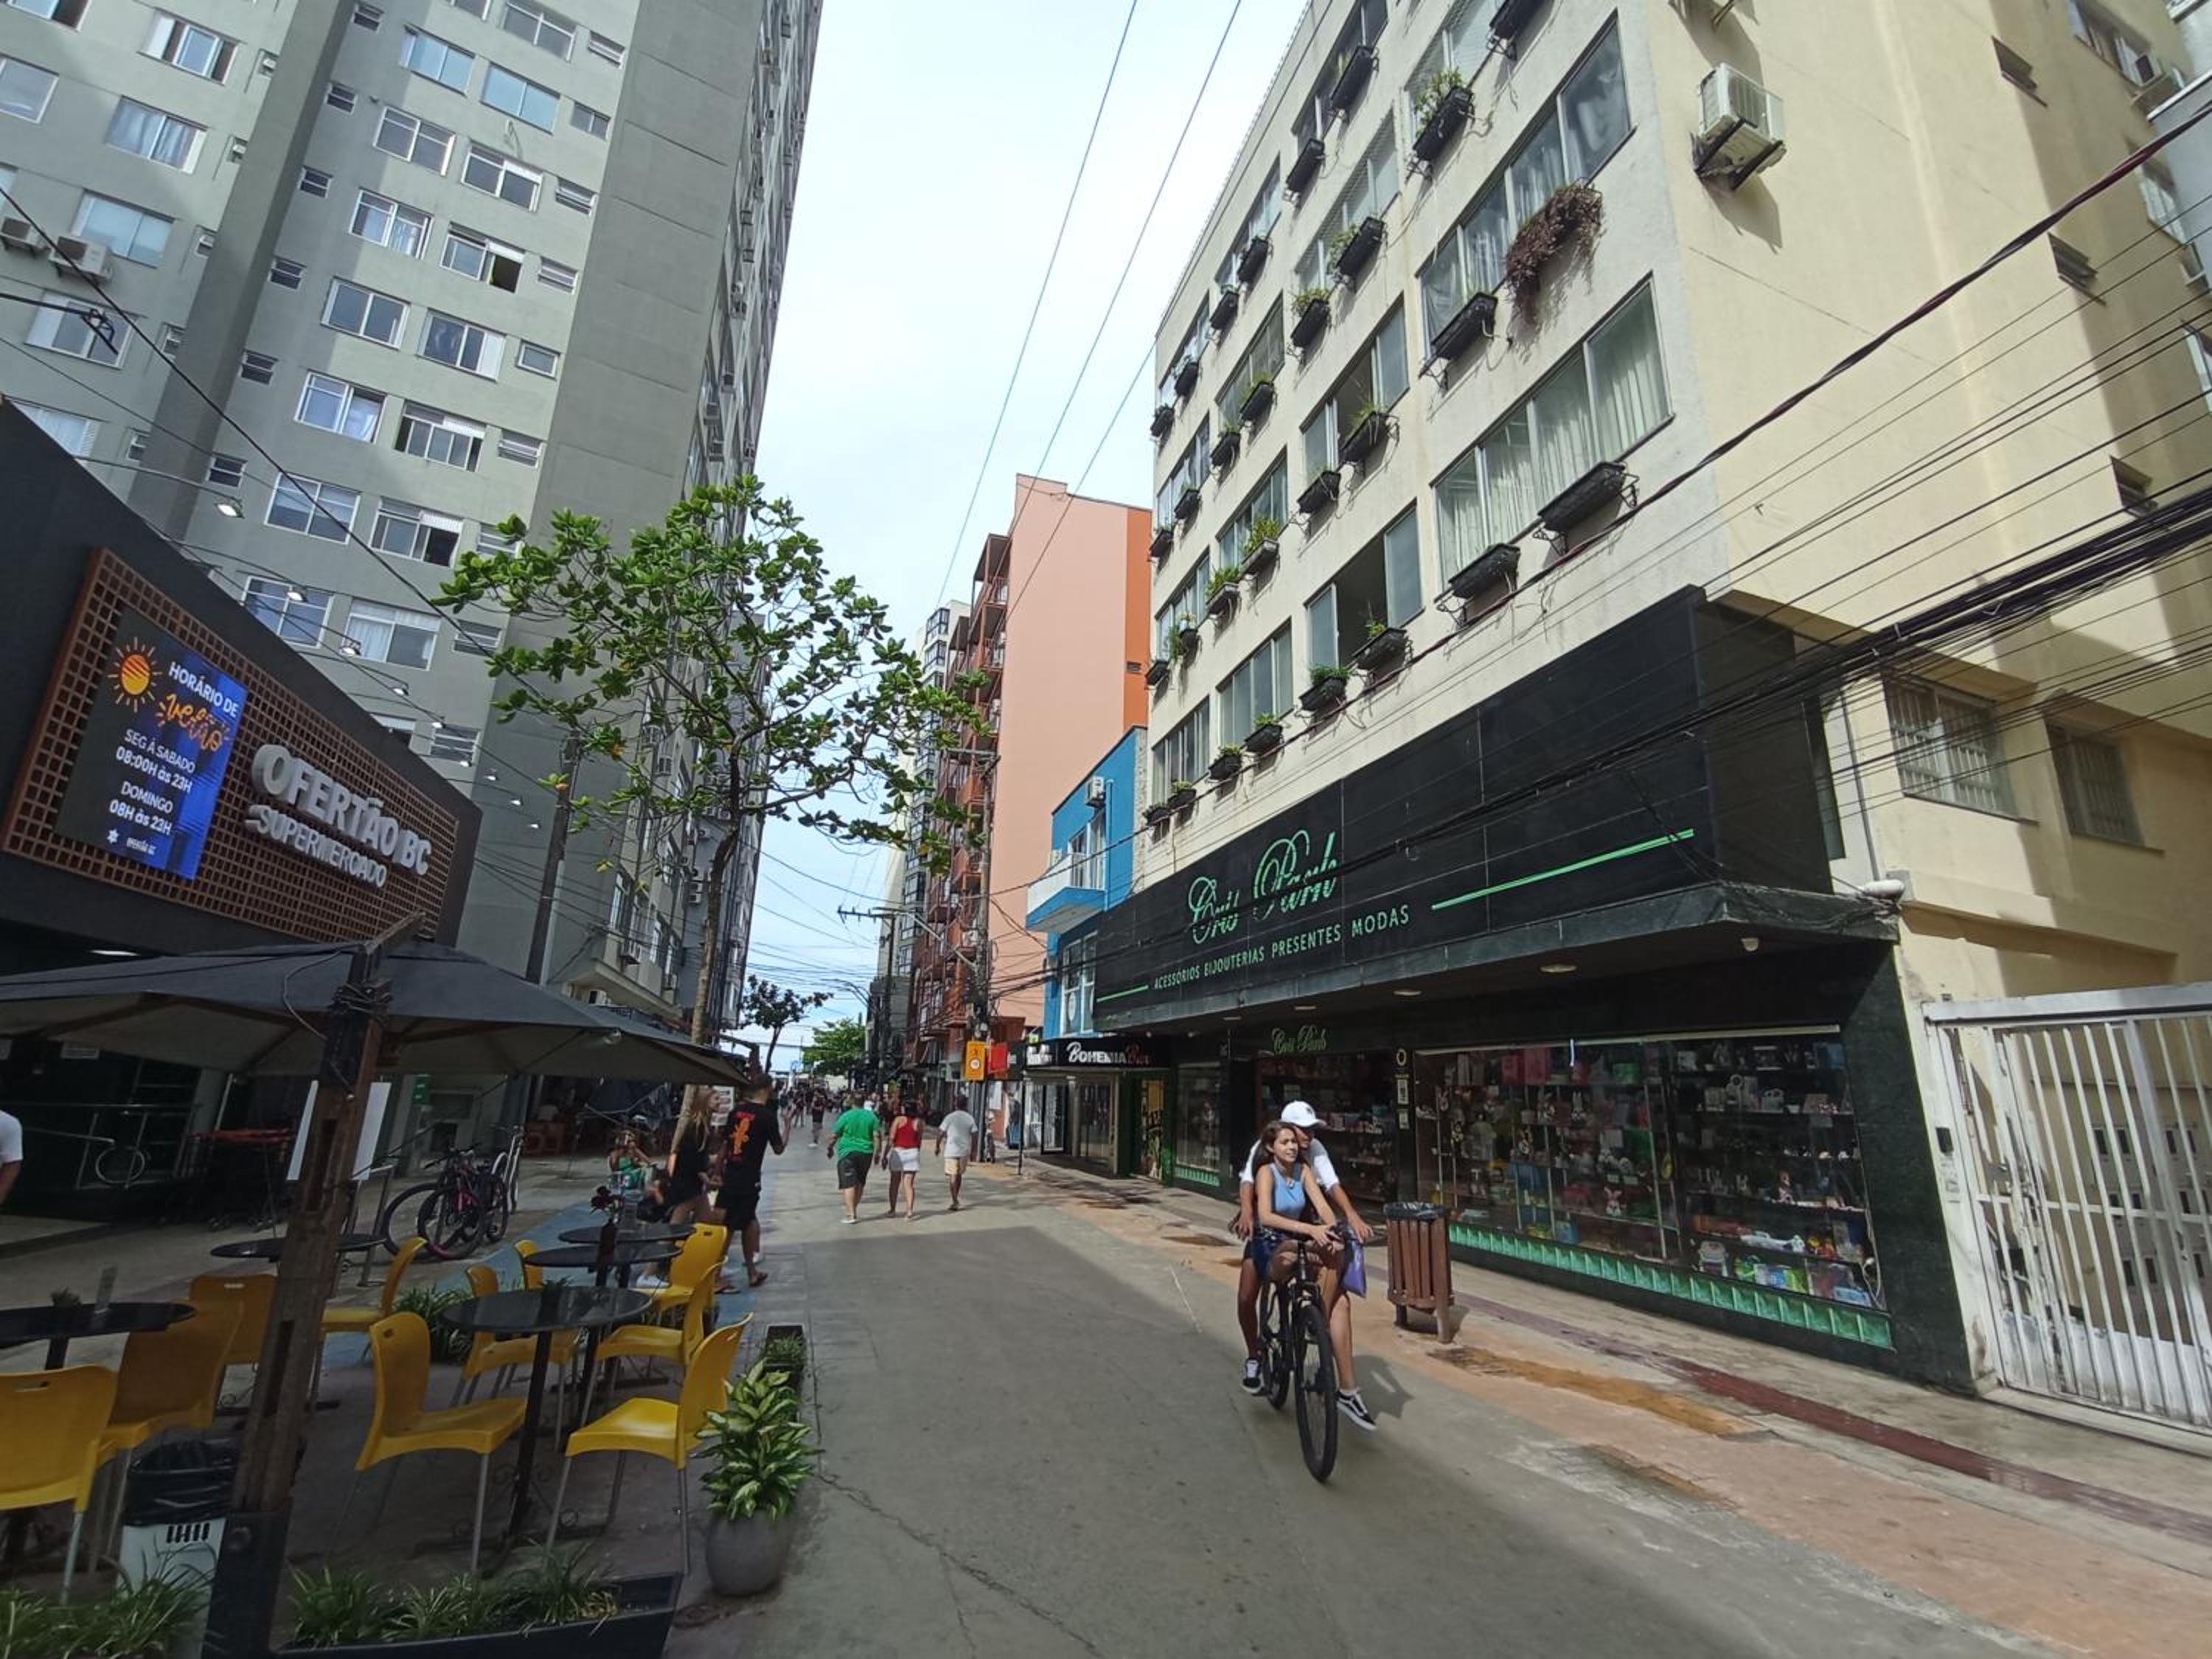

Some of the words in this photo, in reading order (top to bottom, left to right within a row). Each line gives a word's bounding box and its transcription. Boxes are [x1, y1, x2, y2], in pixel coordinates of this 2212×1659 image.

[168, 661, 223, 707] HORÁRIO
[223, 698, 240, 718] DE
[115, 745, 159, 776] 08:00H
[171, 773, 193, 793] 23H
[124, 728, 147, 750] SEG
[156, 745, 196, 773] SABADO
[109, 799, 136, 821] 08H
[150, 815, 173, 835] 23H
[120, 780, 173, 814] DOMINGO
[252, 743, 400, 857] OFERTÃO
[397, 828, 433, 876] BC
[246, 804, 388, 888] SUPERMERCADO
[1203, 945, 1265, 977] BIJOUTERIAS
[1271, 923, 1342, 959] PRESENTES
[1351, 904, 1410, 937] MODAS
